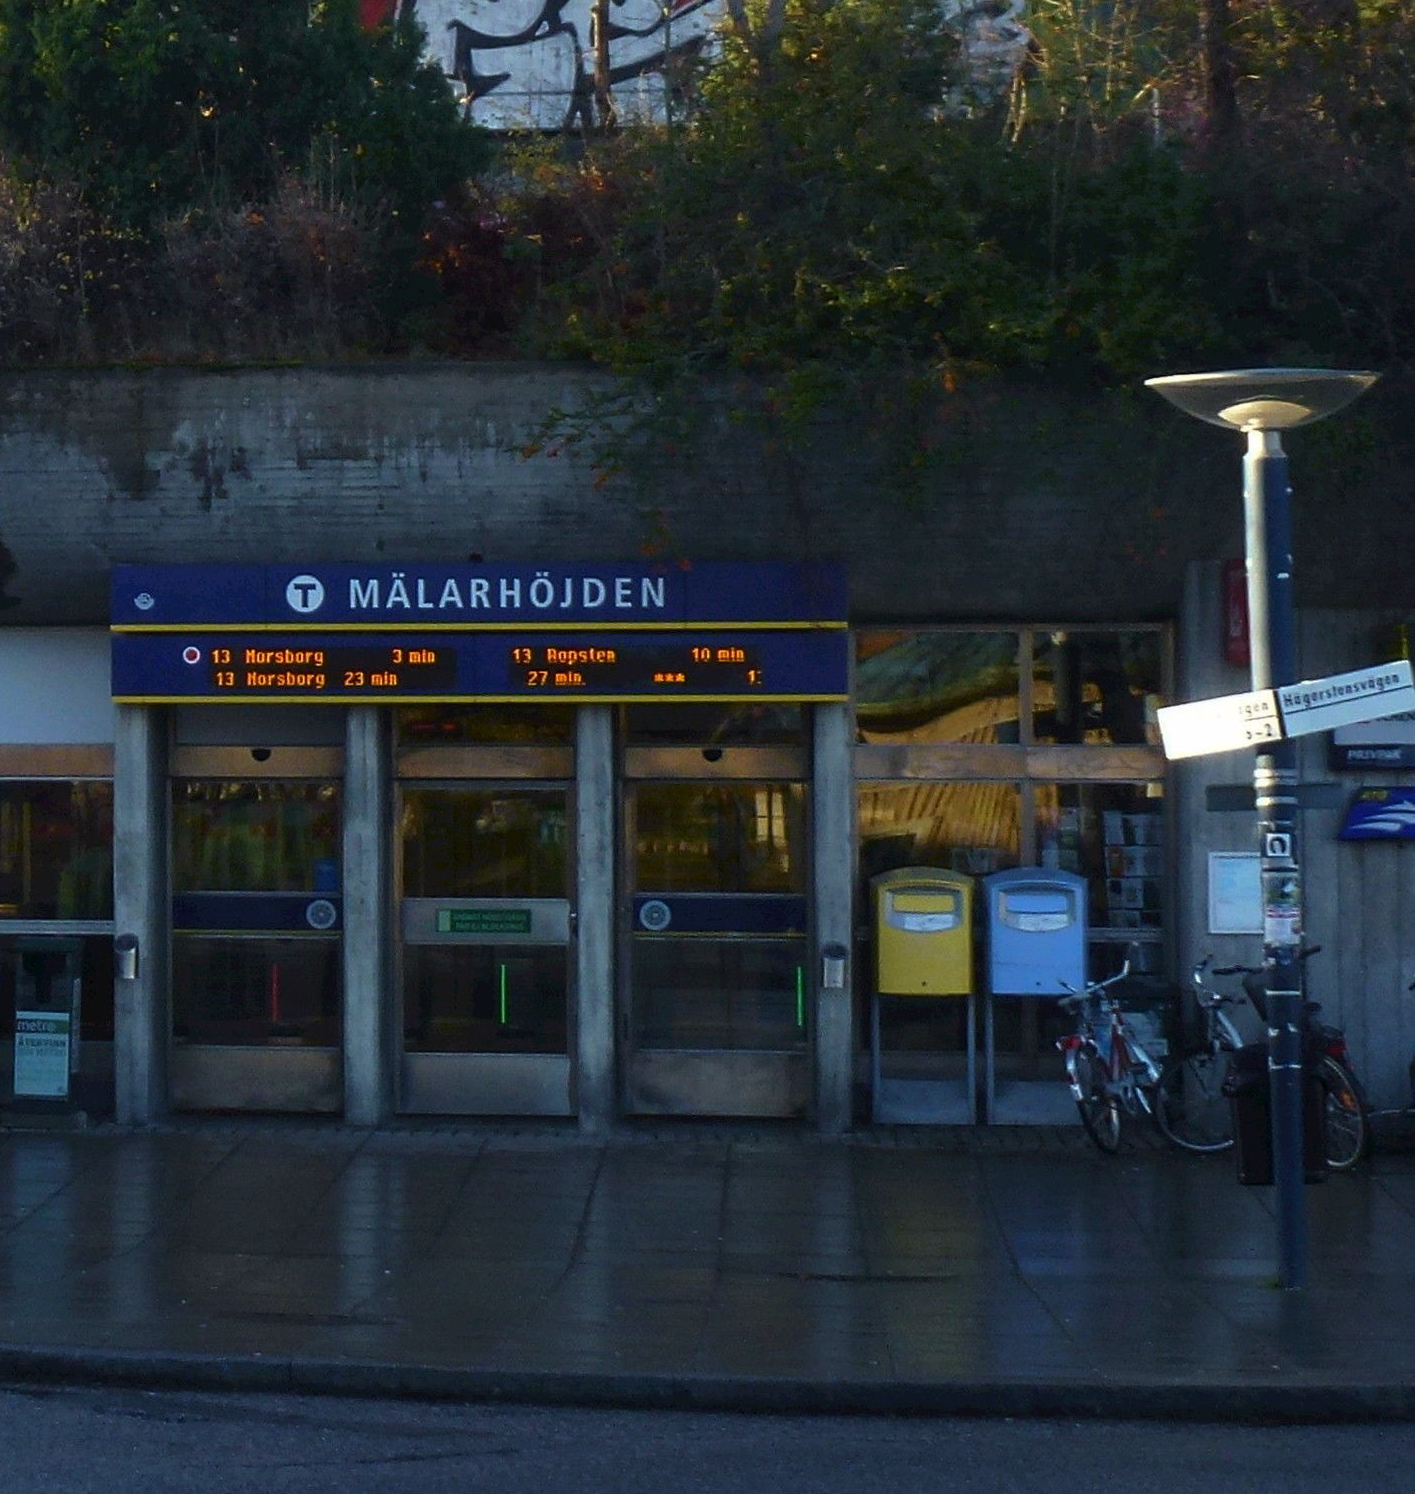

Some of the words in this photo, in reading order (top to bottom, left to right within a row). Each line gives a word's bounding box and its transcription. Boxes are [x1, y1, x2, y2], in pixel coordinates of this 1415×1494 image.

[349, 572, 665, 609] MÄLARHÖJDEN
[211, 649, 231, 664] 13
[245, 649, 324, 665] Norsborg
[392, 649, 403, 664] 3
[408, 649, 435, 663] min
[512, 648, 532, 664] 13
[547, 647, 616, 665] Ropsten
[691, 647, 710, 663] 10
[717, 647, 745, 663] min
[216, 672, 234, 686] 13
[247, 671, 325, 688] Norsborg
[344, 671, 364, 686] 23
[370, 671, 398, 686] min
[527, 670, 549, 686] 27
[1283, 673, 1400, 707] Hägerstensvägen
